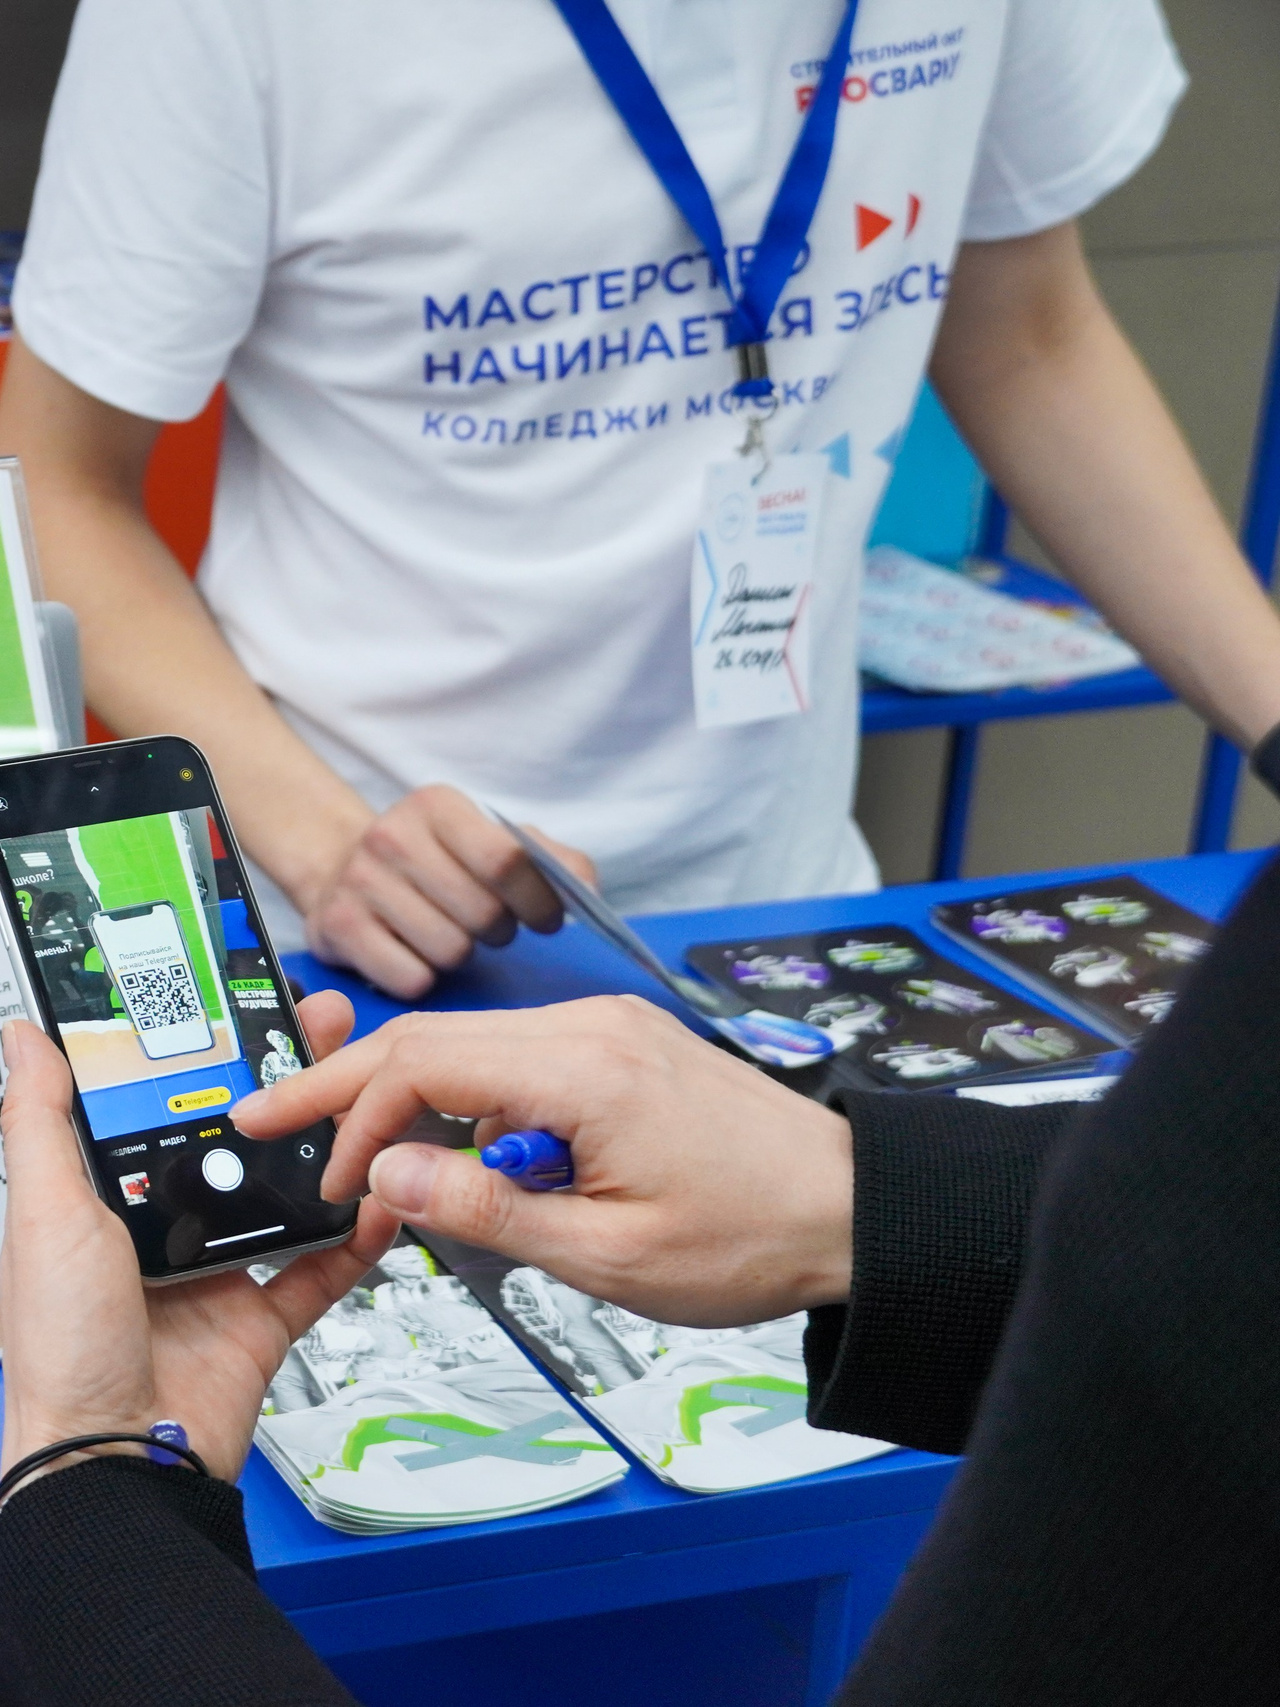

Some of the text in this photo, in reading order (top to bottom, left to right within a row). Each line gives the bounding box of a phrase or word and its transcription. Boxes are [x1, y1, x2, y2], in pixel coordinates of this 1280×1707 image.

[423, 297, 813, 384] НАЧИНАЕТЯ
[422, 402, 668, 444] КОЛЛЕДЖИ
[12, 868, 56, 887] школе?
[183, 1094, 215, 1107] Telegram
[159, 1134, 187, 1148] ВИДЕО
[198, 1126, 222, 1139] ФОТО
